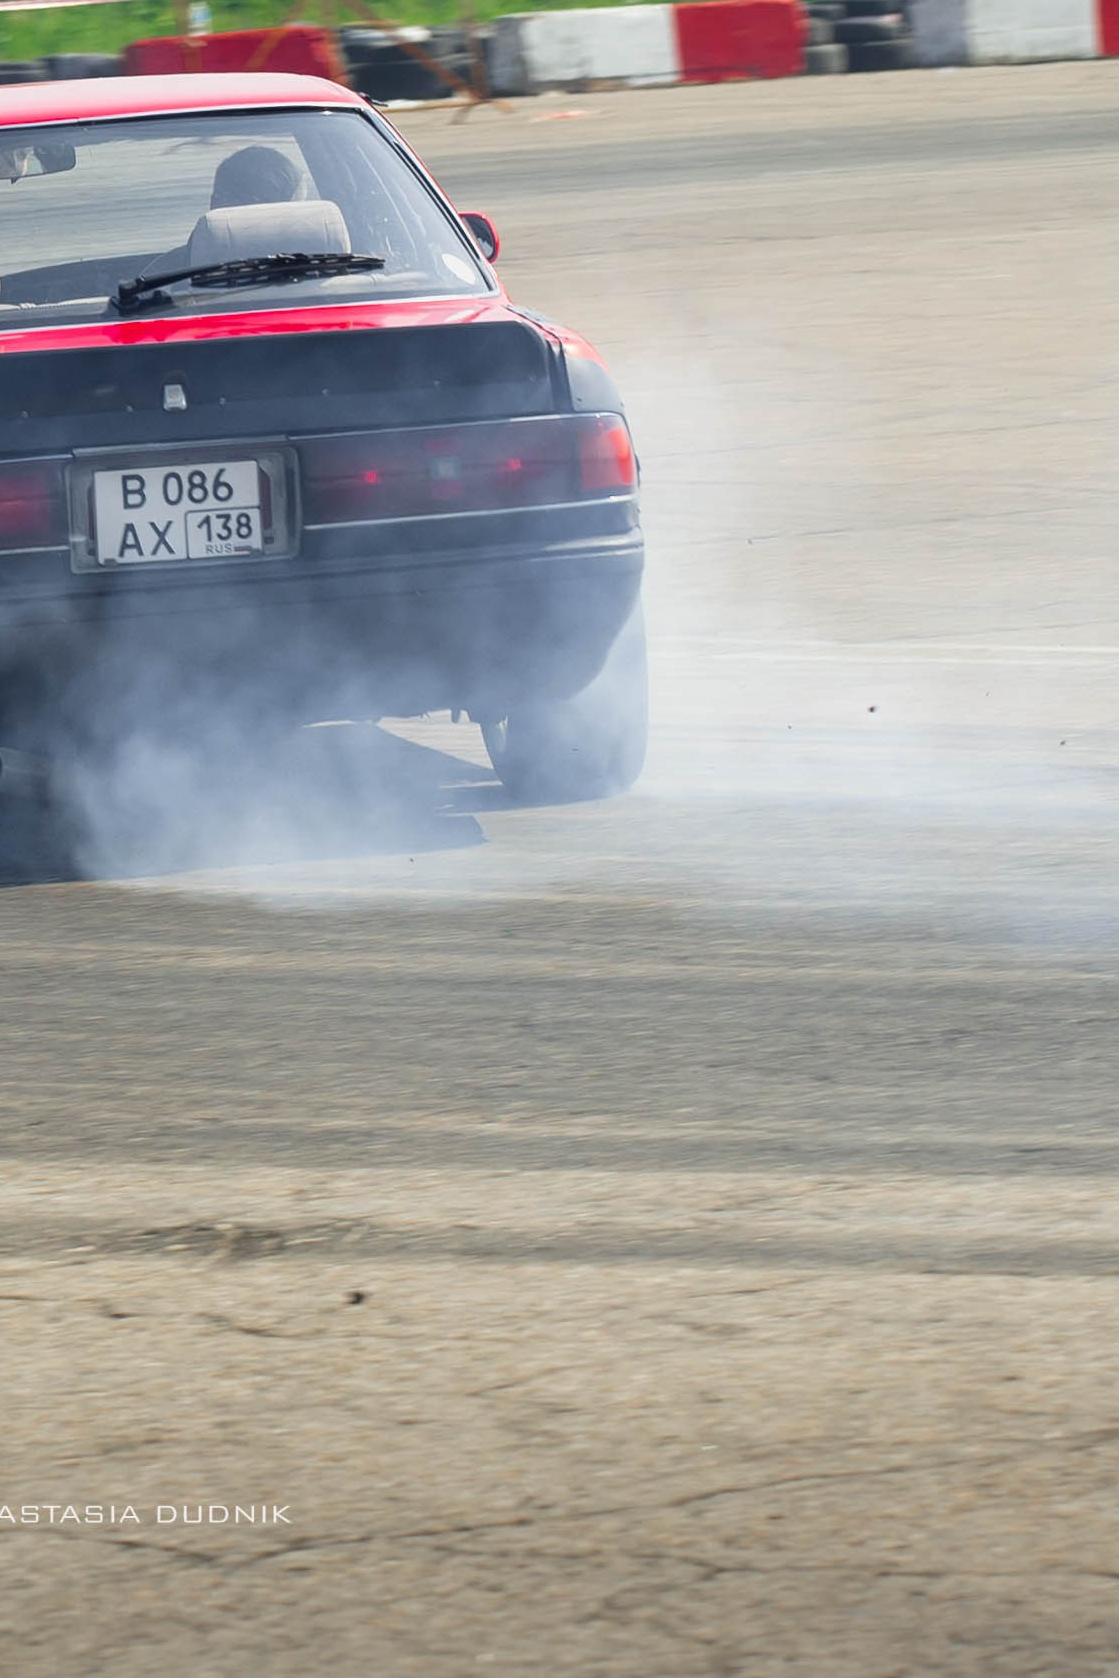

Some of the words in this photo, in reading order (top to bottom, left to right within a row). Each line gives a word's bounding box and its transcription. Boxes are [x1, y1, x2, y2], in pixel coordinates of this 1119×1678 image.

[162, 468, 234, 506] 086
[197, 512, 253, 542] 138
[205, 542, 233, 554] RUS
